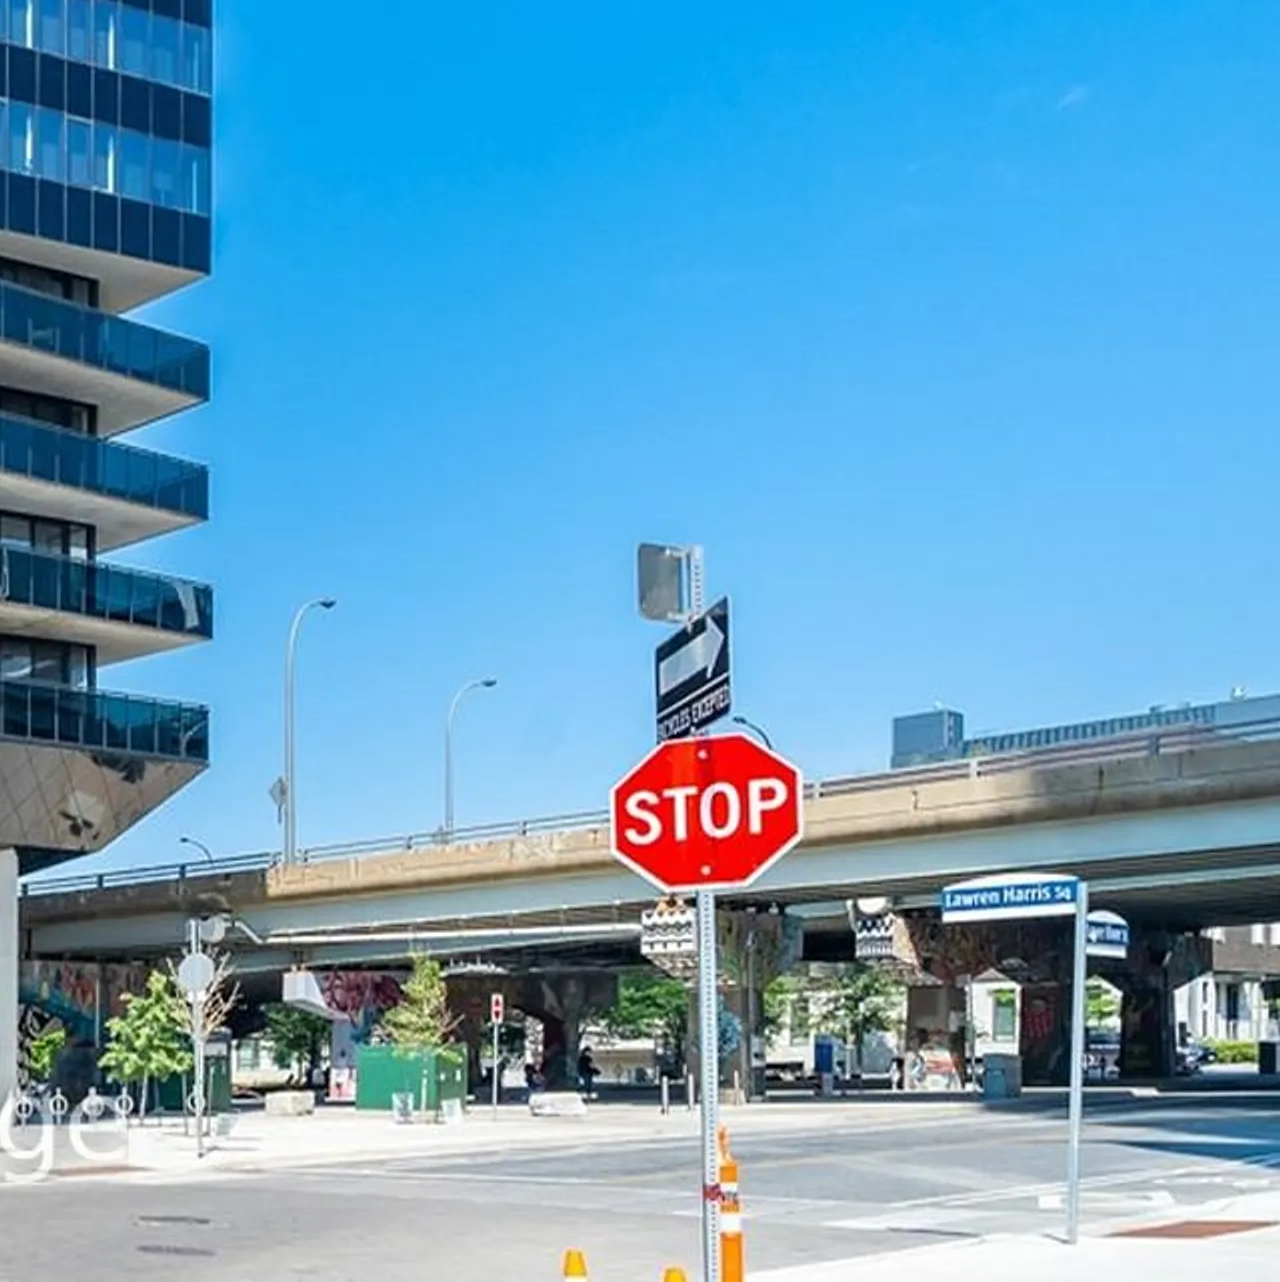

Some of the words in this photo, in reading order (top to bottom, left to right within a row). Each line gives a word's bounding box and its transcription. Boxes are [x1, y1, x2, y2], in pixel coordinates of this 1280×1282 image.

[624, 777, 788, 846] STOP
[945, 890, 1000, 908] Lawren
[1003, 886, 1050, 902] Harris
